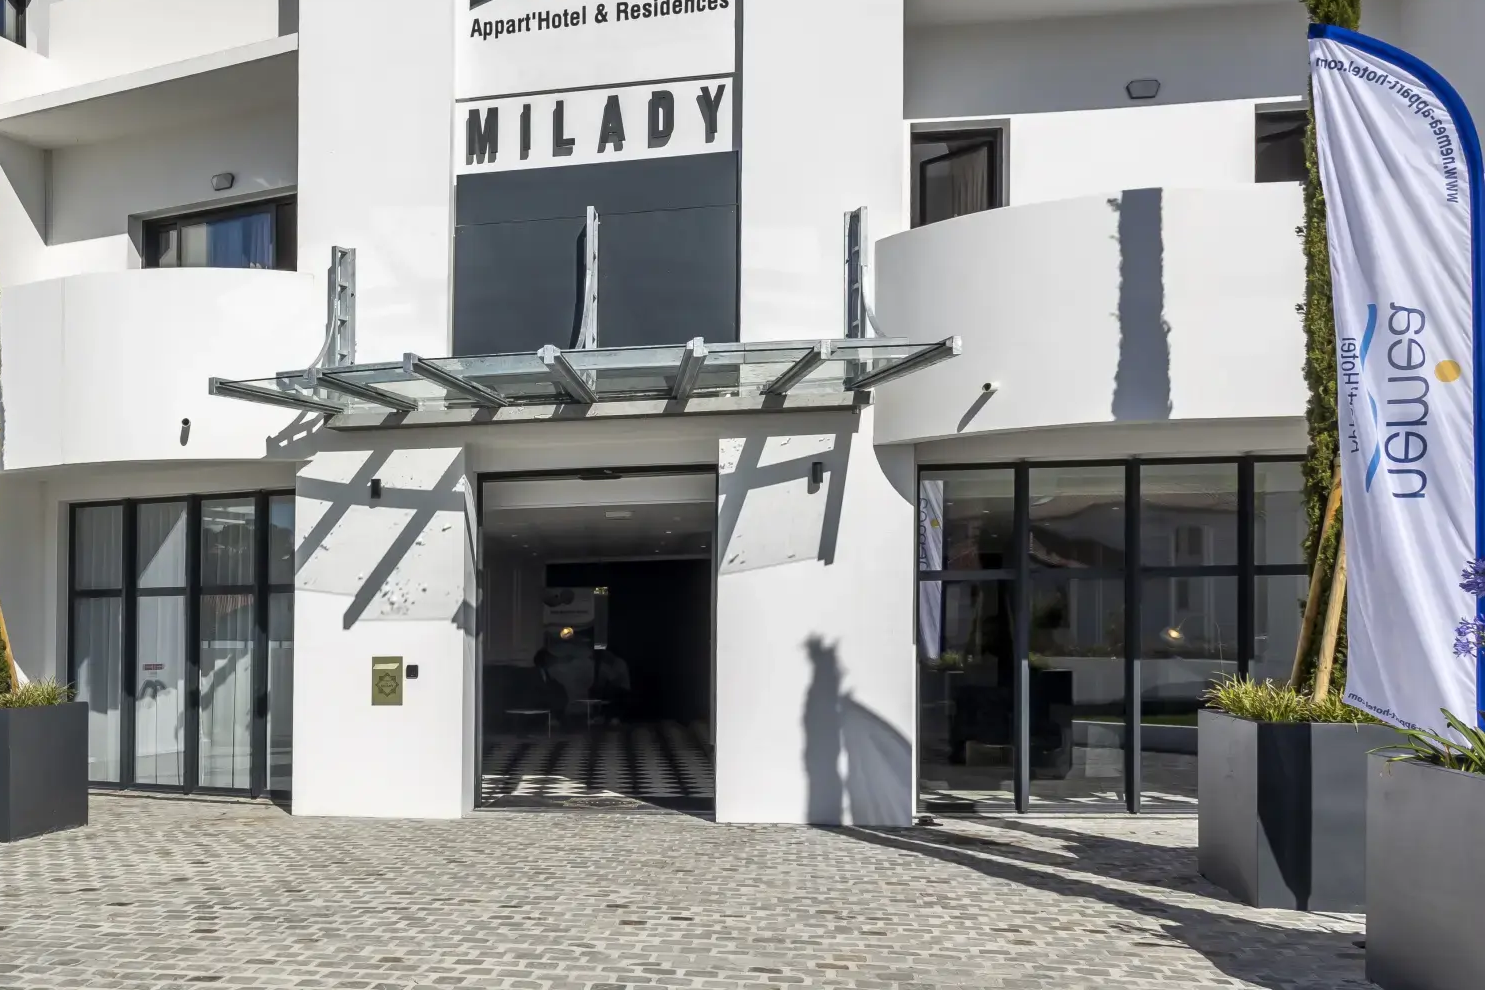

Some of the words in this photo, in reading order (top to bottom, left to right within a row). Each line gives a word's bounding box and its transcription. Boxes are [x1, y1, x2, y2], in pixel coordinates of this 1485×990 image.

[470, 5, 587, 40] Appart'Hotel
[594, 3, 609, 24] &
[466, 84, 726, 165] MILADY
